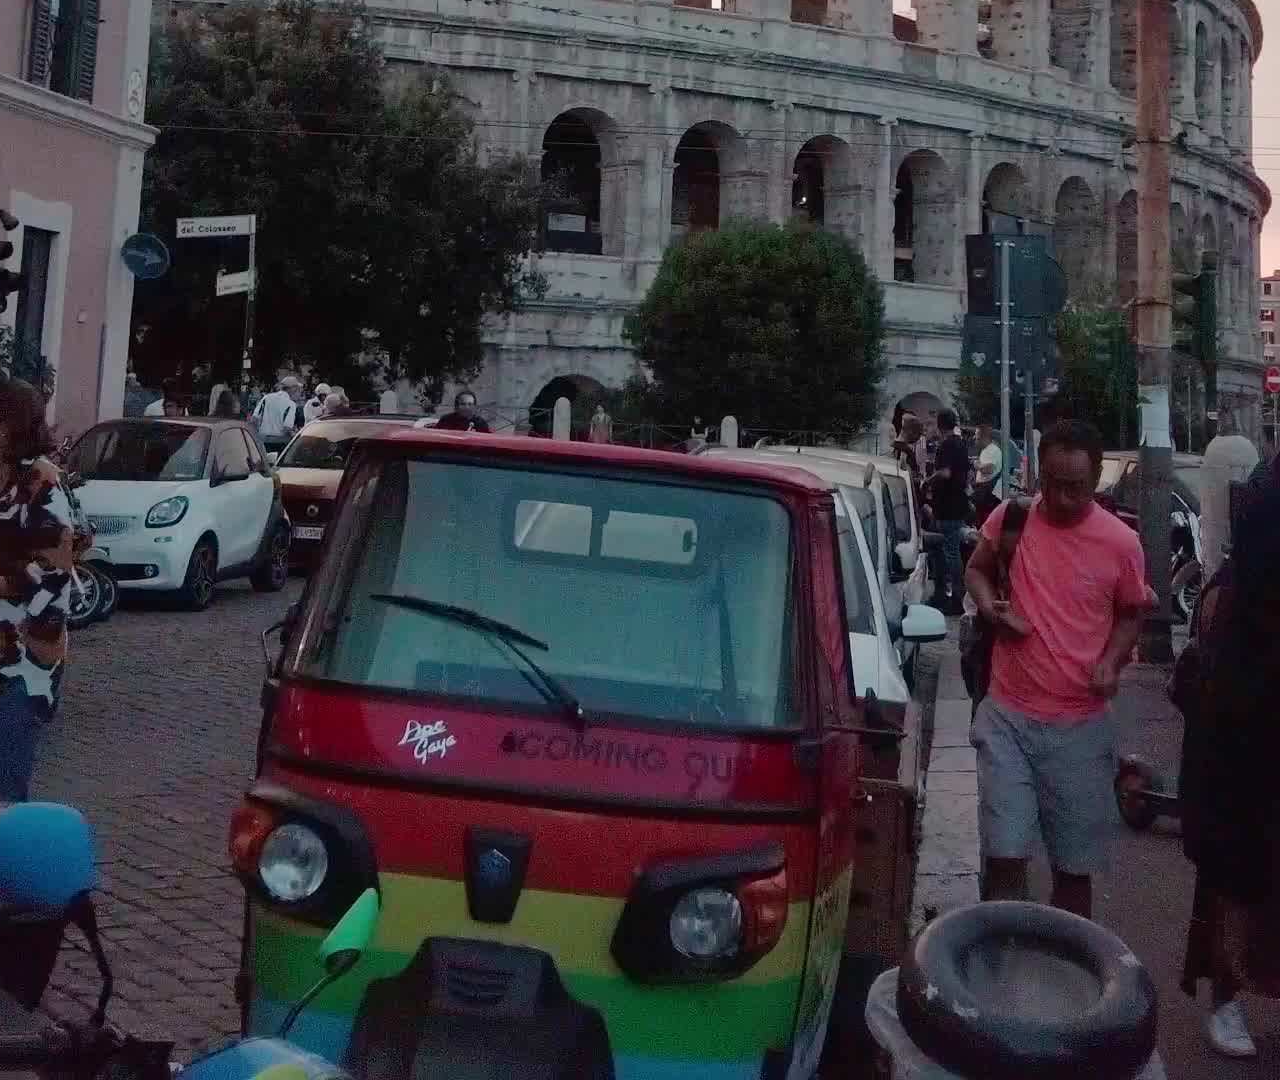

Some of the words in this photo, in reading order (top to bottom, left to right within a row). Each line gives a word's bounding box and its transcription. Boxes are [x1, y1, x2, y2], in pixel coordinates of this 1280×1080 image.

[180, 224, 194, 234] del
[198, 224, 237, 233] Colosseo
[398, 719, 449, 746] Ape
[413, 734, 458, 766] Gaya
[519, 731, 668, 771] COMING
